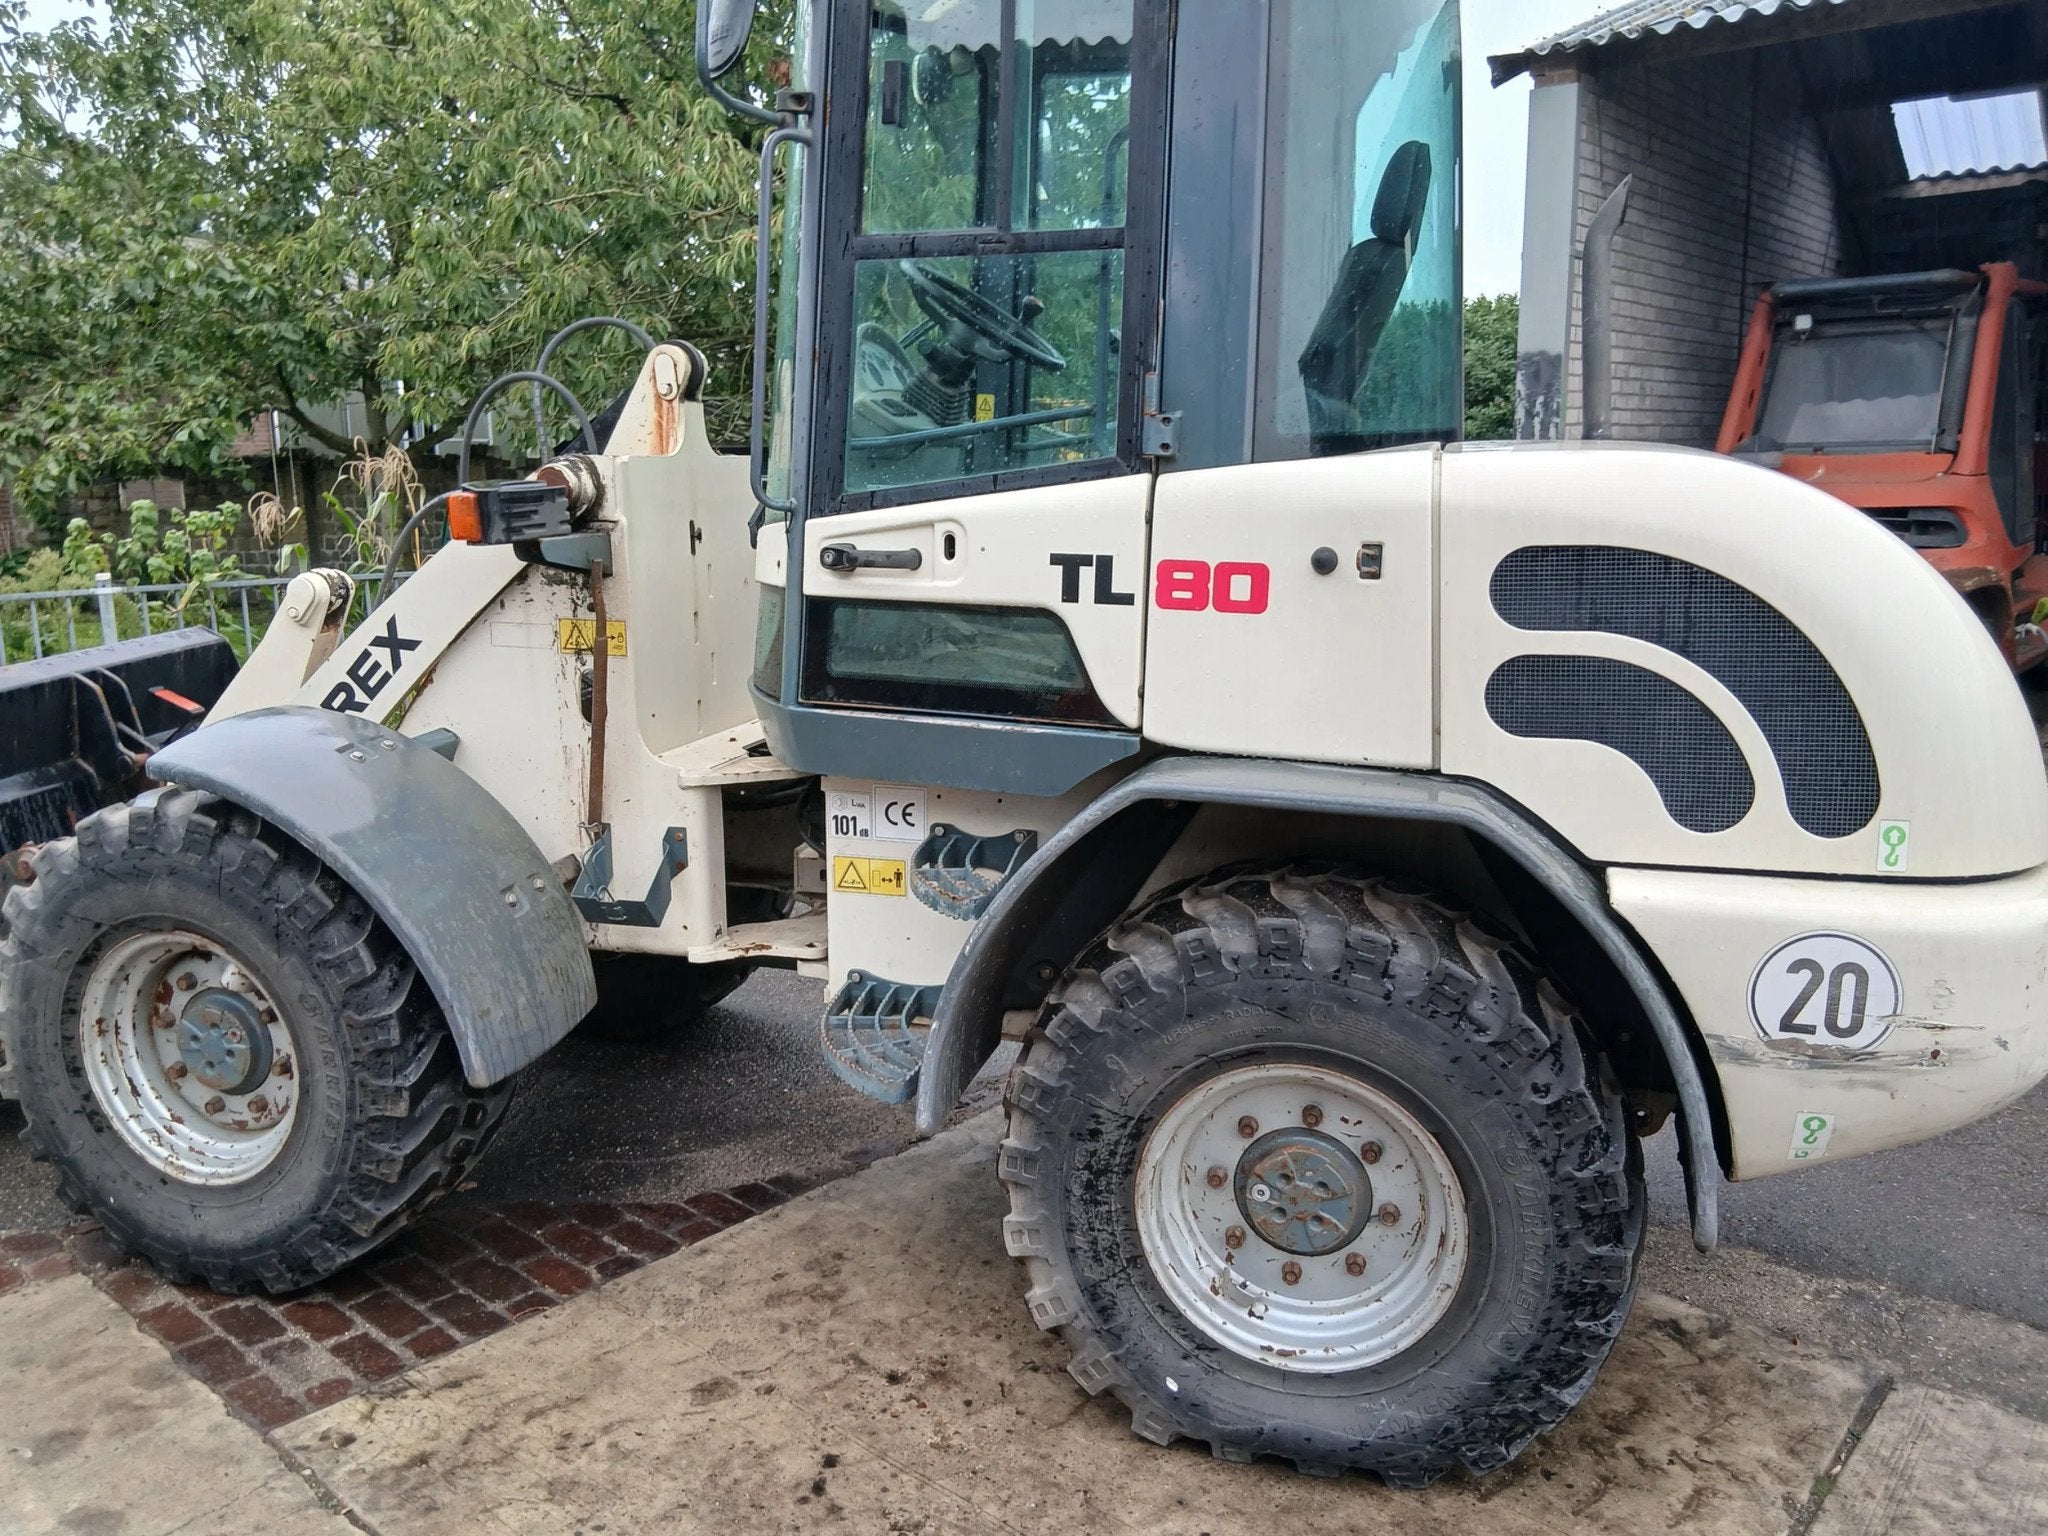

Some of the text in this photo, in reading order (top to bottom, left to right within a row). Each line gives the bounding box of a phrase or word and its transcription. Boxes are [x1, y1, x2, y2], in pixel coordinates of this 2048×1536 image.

[1050, 552, 1271, 615] TL 80
[832, 814, 869, 837] 101 dB
[884, 801, 916, 827] CE
[1779, 957, 1870, 1039] 20
